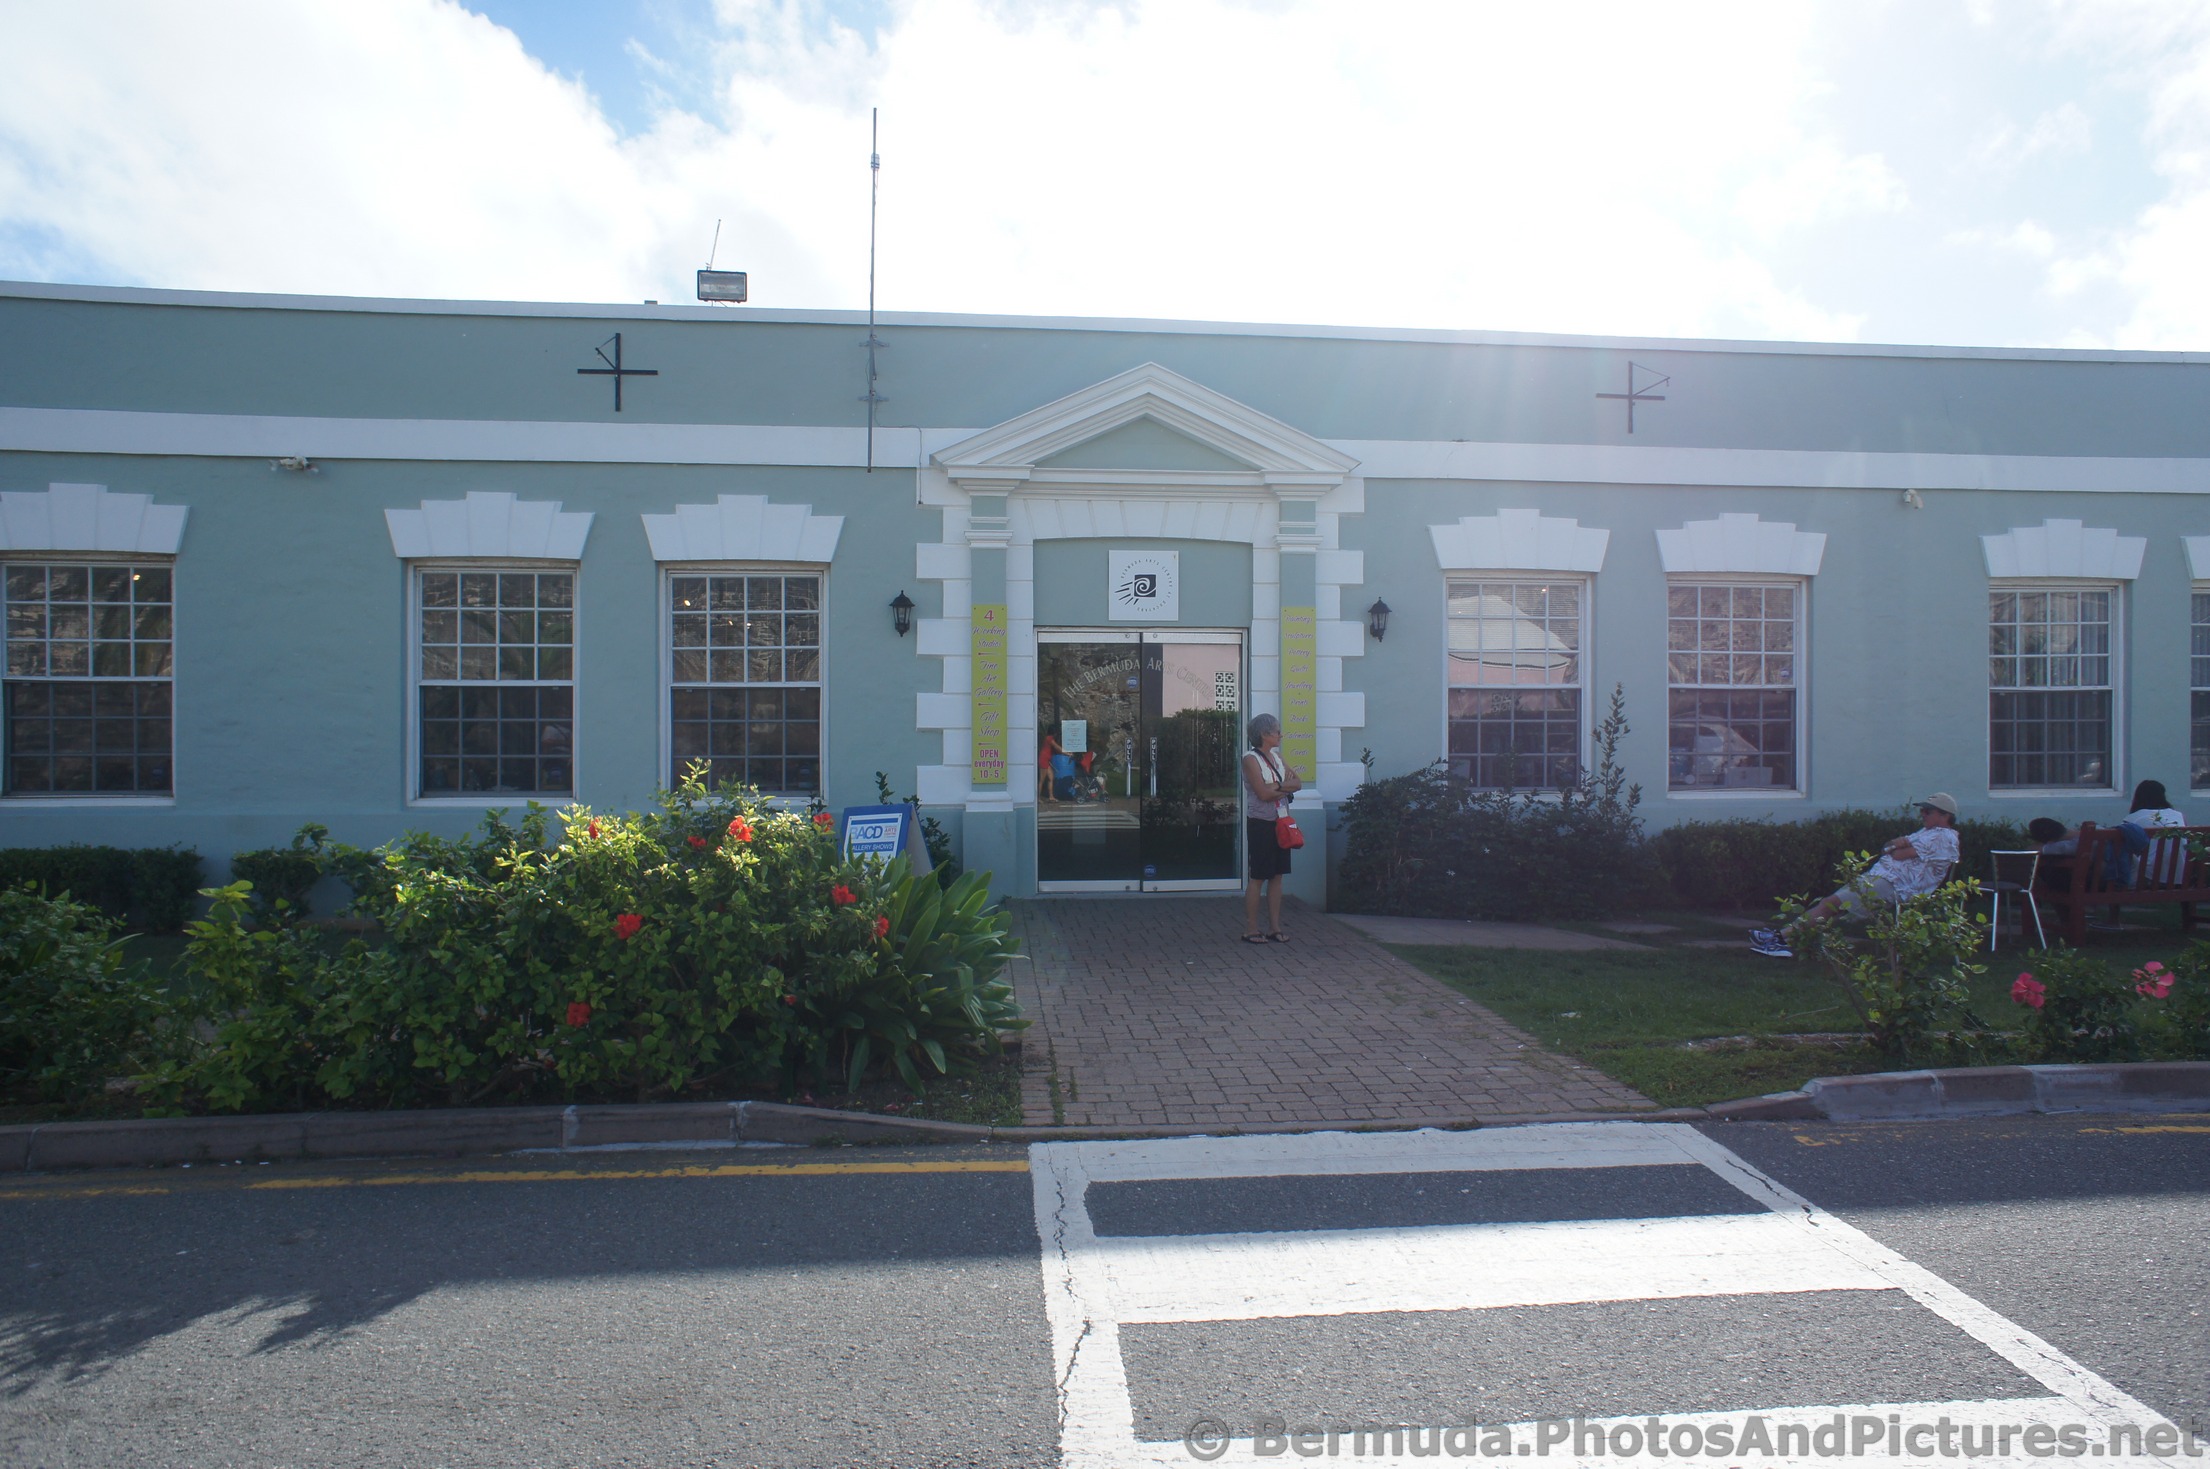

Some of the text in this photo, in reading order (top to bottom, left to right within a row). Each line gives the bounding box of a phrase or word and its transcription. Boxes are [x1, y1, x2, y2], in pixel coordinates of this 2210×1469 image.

[984, 610, 994, 621] 4
[973, 625, 1006, 636] Working
[980, 660, 998, 670] Fine
[981, 674, 997, 683] Art
[1061, 679, 1085, 699] THE
[1083, 659, 1141, 684] BERMUDA
[975, 687, 1003, 699] Gallery
[980, 711, 999, 723] Gift
[978, 725, 1000, 738] Shop
[980, 749, 999, 758] OPEN
[974, 759, 1005, 769] everyday
[980, 770, 988, 778] 10
[994, 770, 999, 778] 5
